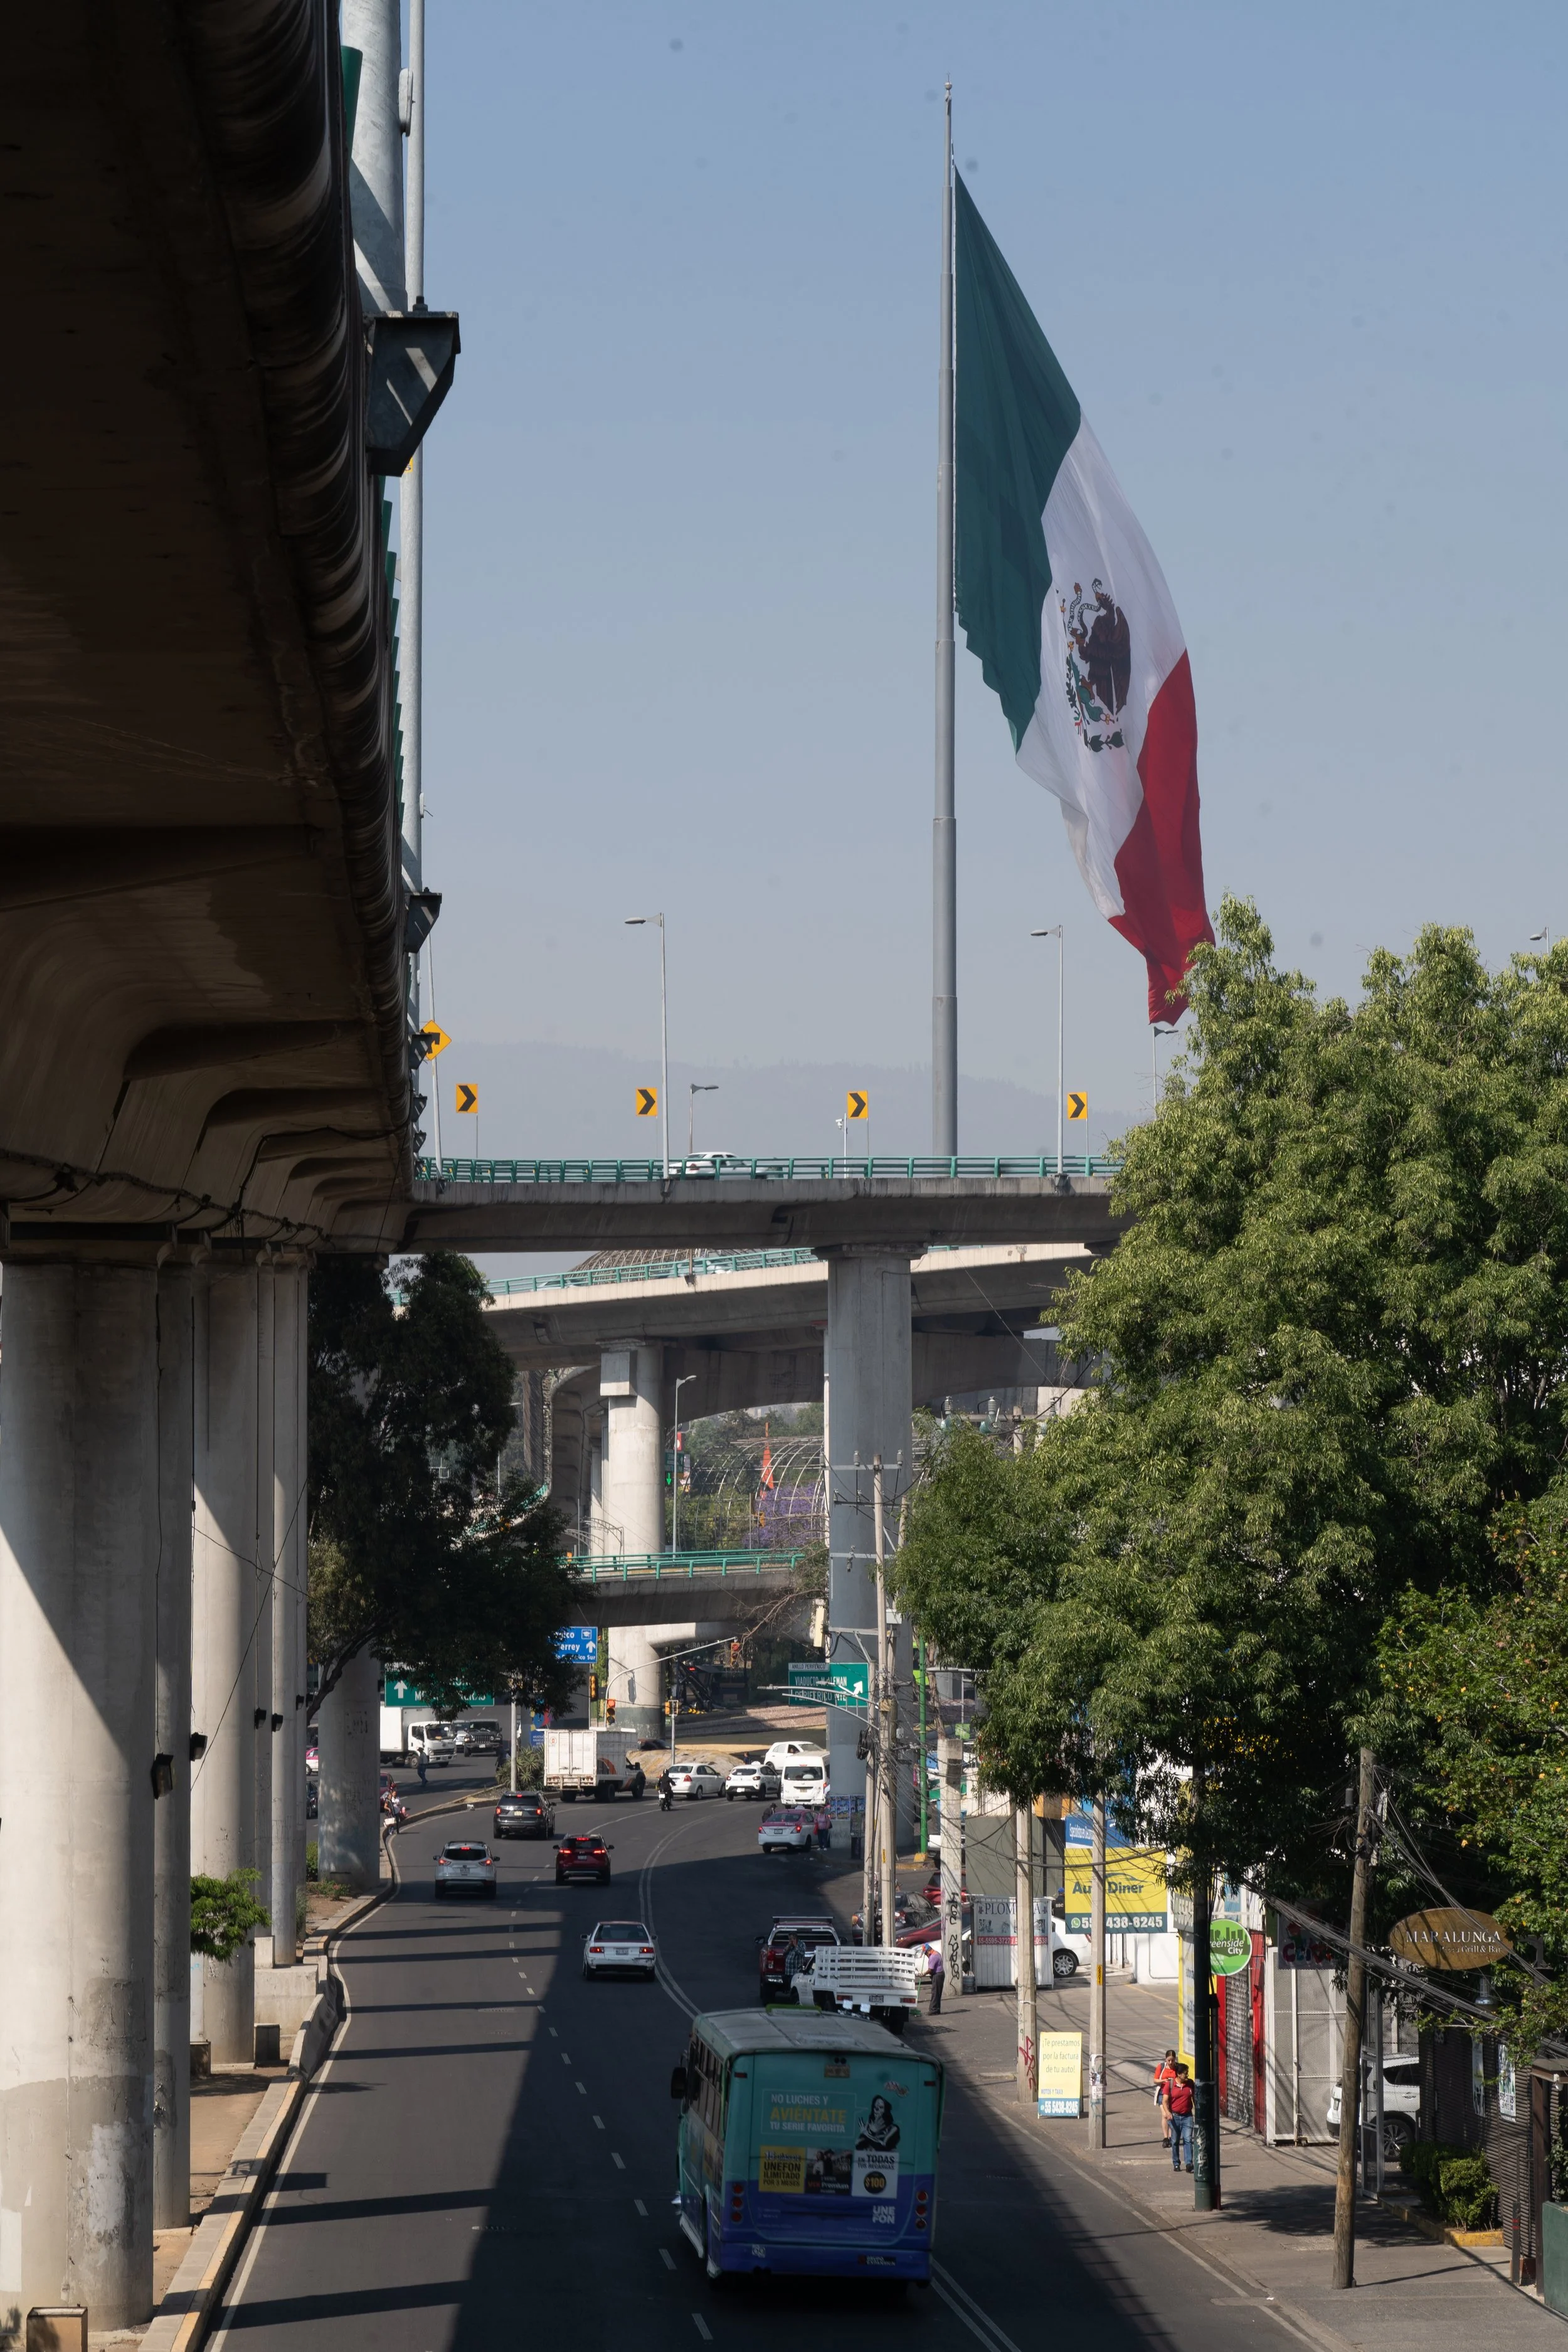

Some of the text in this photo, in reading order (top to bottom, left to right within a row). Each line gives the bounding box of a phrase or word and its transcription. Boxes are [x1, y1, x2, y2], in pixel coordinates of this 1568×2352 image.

[795, 1676, 819, 1687] VIADUCTO
[1108, 1881, 1144, 1894] Diner
[985, 1902, 1041, 1915] PLOMA
[1106, 1916, 1163, 1929] 438-8245
[1210, 1938, 1244, 1948] reenside
[1227, 1947, 1243, 1956] City
[1051, 2039, 1080, 2047] prestamos
[1042, 2052, 1079, 2062] por la factura
[1046, 2064, 1052, 2073] de
[1061, 2065, 1076, 2073] auto!
[771, 2094, 829, 2106] NO LUCHES Y
[1044, 2100, 1078, 2114] 55 5438-8245
[770, 2105, 847, 2124] AVIÉNTATE
[770, 2121, 845, 2133] TU SERIE FAVORITA
[866, 2154, 894, 2164] TODAS
[764, 2161, 801, 2172] UNEFON
[763, 2171, 800, 2180] ILIMITADO
[865, 2176, 885, 2188] $100
[872, 2205, 896, 2215] UNE
[872, 2215, 895, 2224] FON
